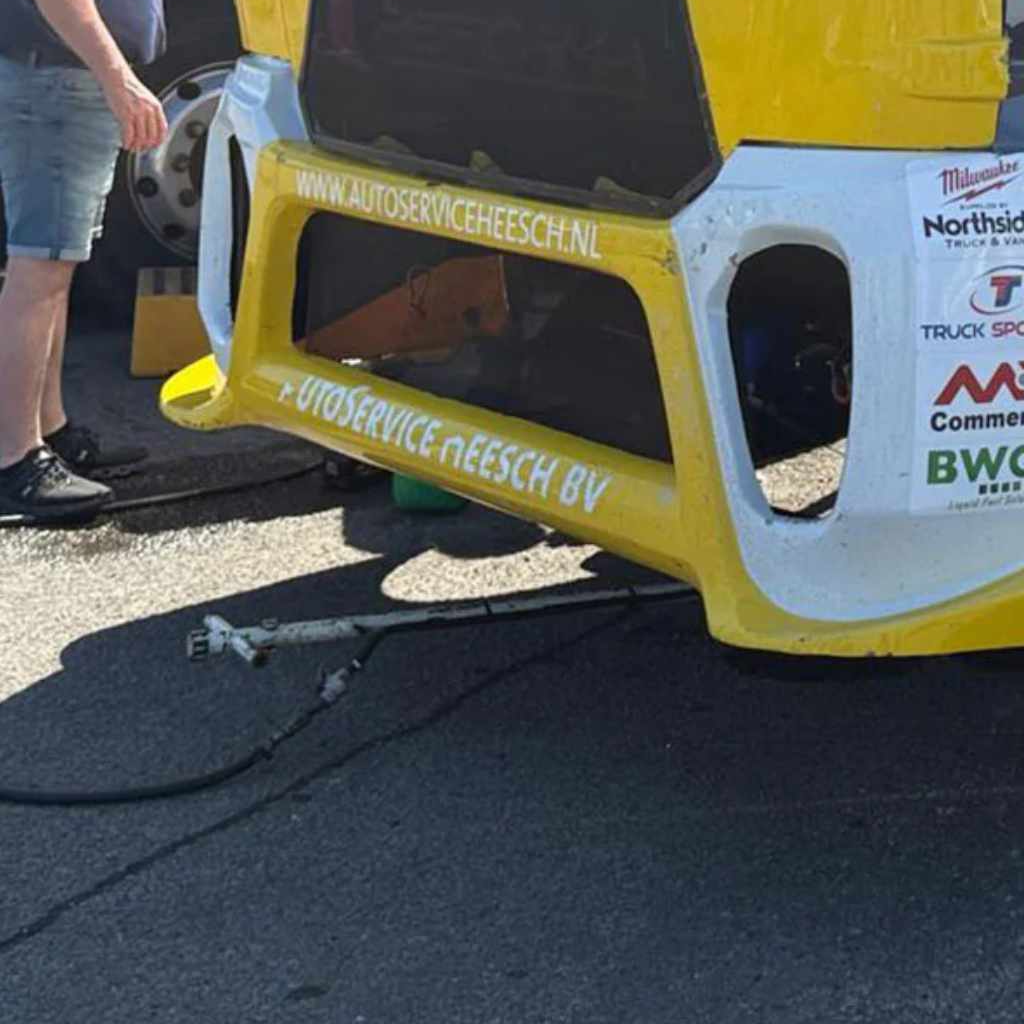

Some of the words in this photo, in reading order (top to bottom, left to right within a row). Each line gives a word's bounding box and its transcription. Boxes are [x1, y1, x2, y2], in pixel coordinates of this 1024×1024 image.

[296, 169, 602, 260] WWW.AUTOSERVICEHEESCH.NL
[945, 238, 986, 249] TRUCK
[990, 237, 999, 247] &
[920, 322, 984, 340] TRUCK
[559, 461, 614, 514] BV
